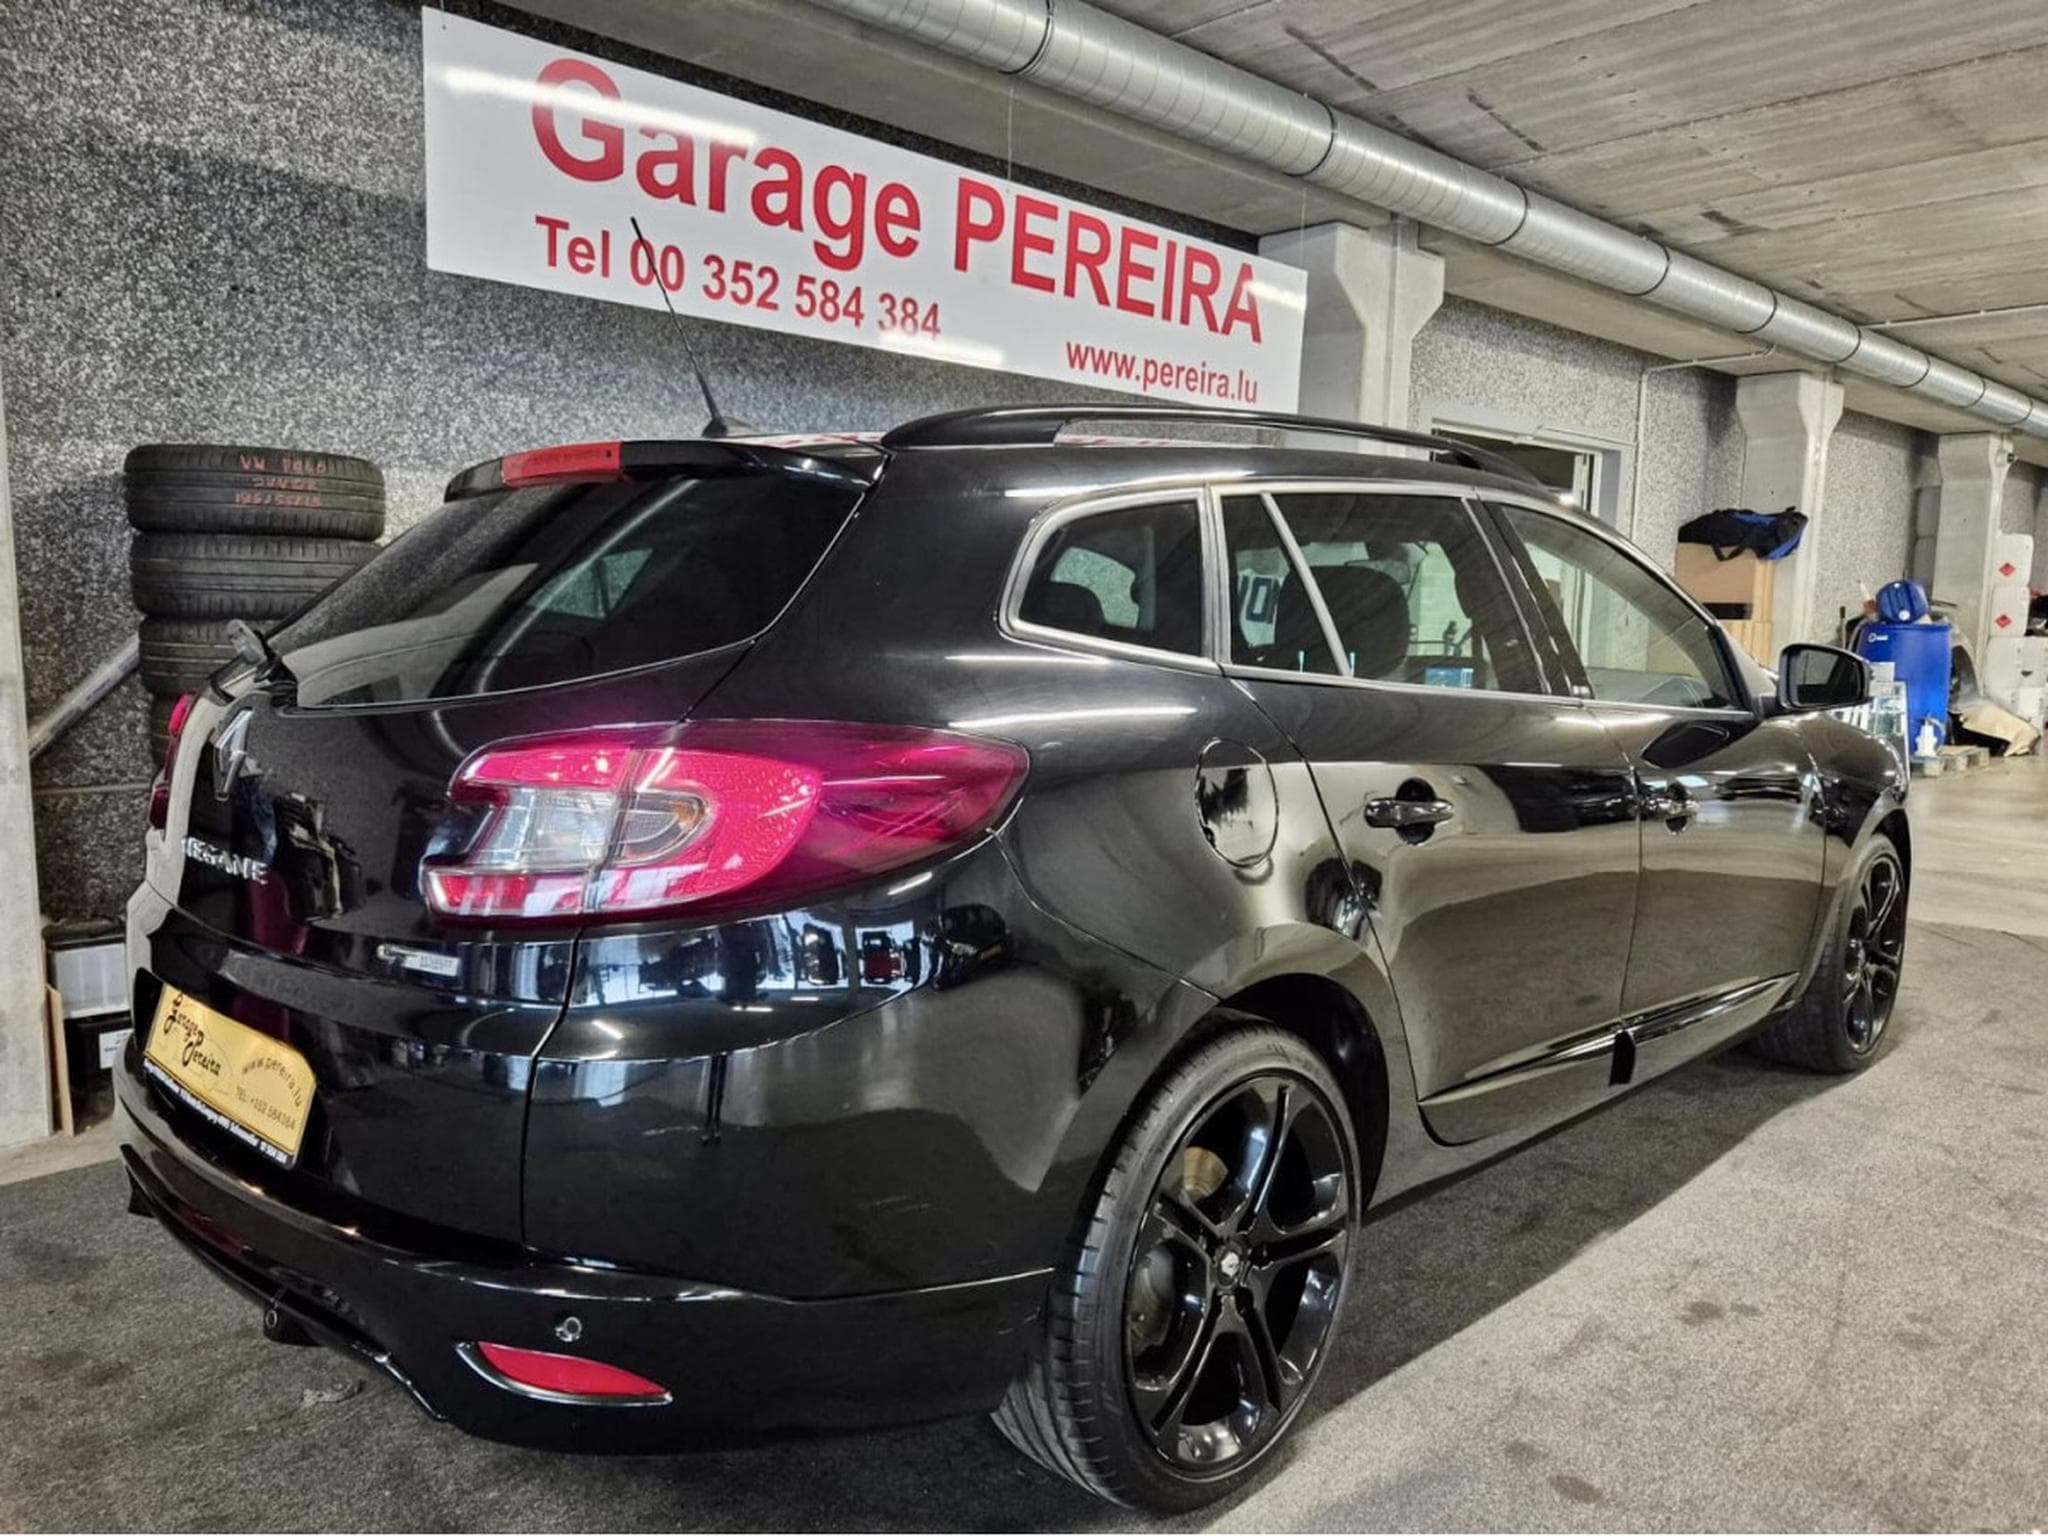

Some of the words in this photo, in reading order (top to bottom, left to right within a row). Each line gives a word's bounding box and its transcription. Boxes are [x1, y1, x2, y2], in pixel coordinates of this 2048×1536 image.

[531, 57, 924, 274] Garage
[952, 175, 1264, 346] PEREIRA
[534, 214, 613, 280] Tel
[629, 238, 687, 295] 00
[702, 253, 780, 313] 352
[795, 273, 865, 328] 584
[878, 291, 941, 341] 384
[1065, 341, 1258, 405] www.pereira.lu
